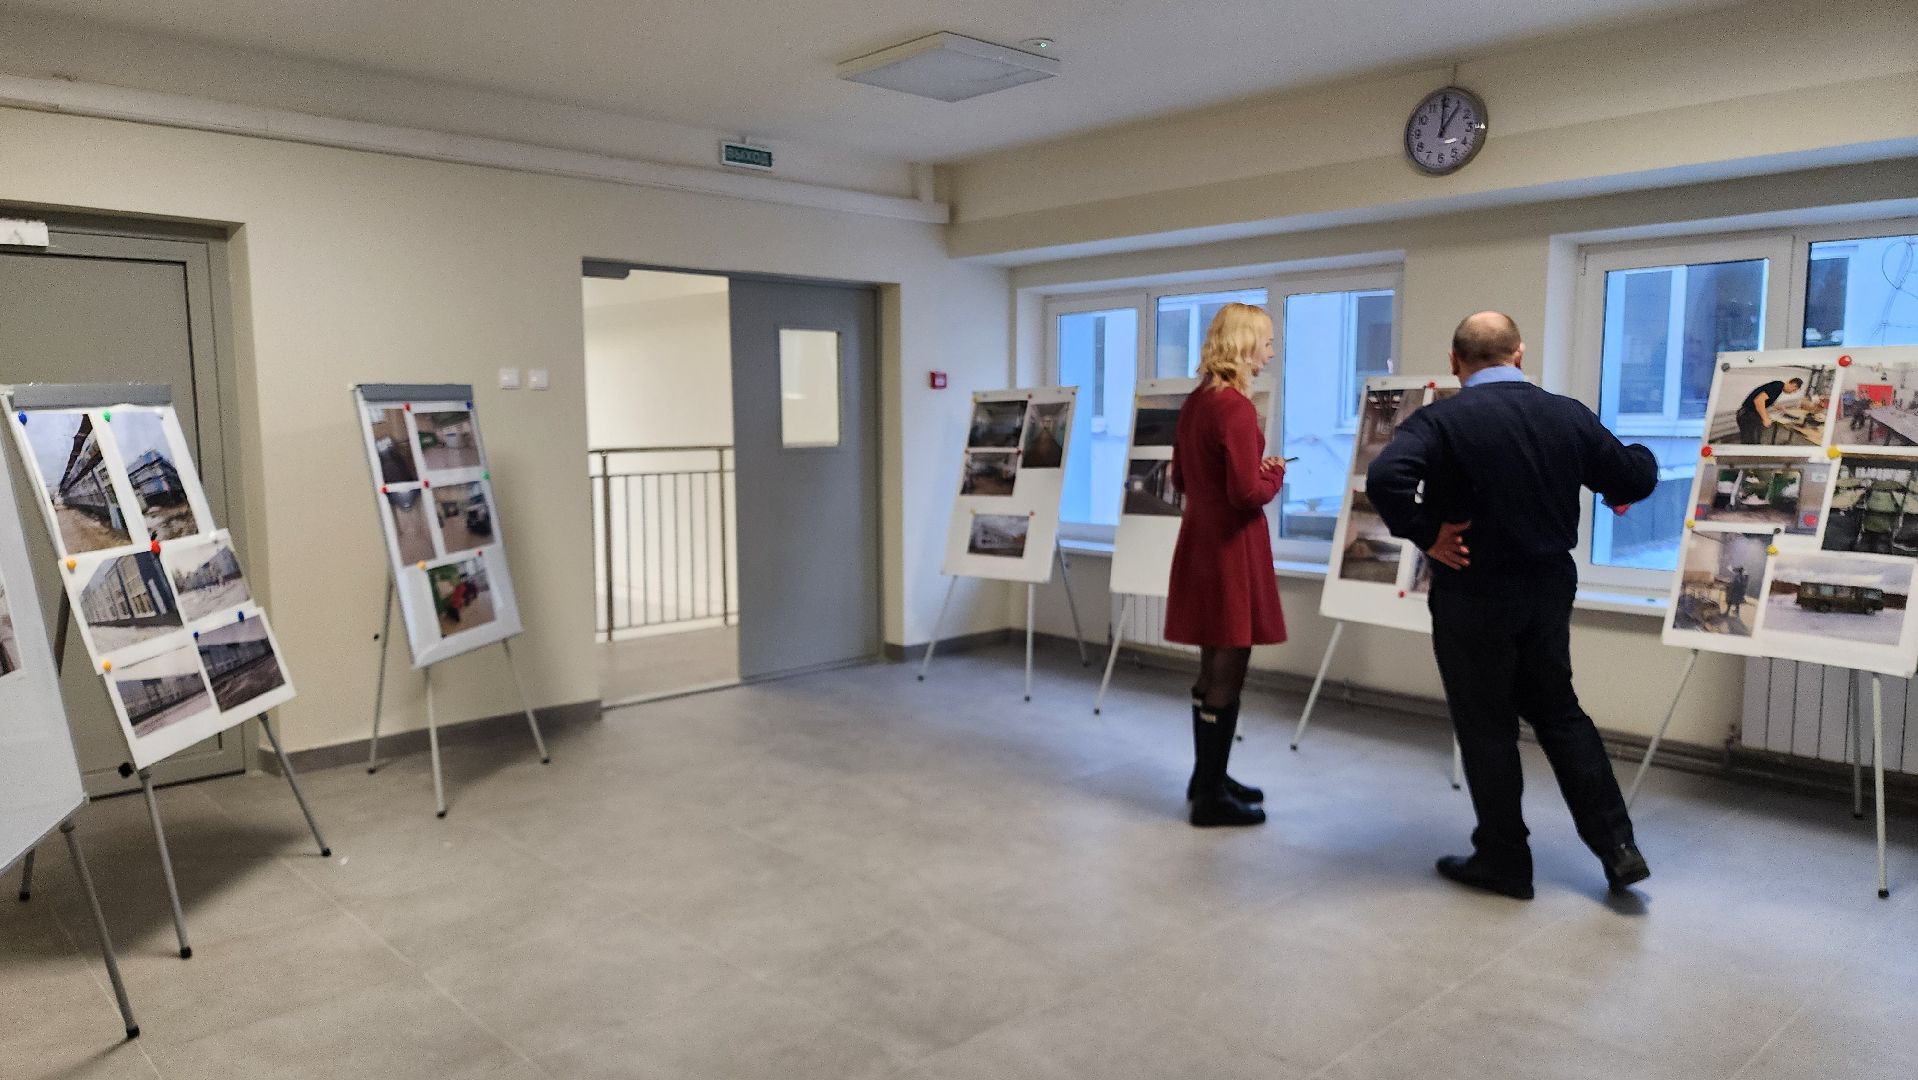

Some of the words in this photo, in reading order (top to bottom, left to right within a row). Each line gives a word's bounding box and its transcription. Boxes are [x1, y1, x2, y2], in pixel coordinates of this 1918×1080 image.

[1428, 104, 1436, 113] 11
[1463, 109, 1472, 119] 2
[1419, 115, 1429, 125] 10
[1465, 121, 1473, 133] 3
[1414, 129, 1421, 140] 9
[1461, 136, 1468, 146] 4
[1416, 141, 1424, 152] 8
[1426, 150, 1433, 160] 7
[1438, 152, 1445, 163] 6
[1451, 147, 1458, 159] 5
